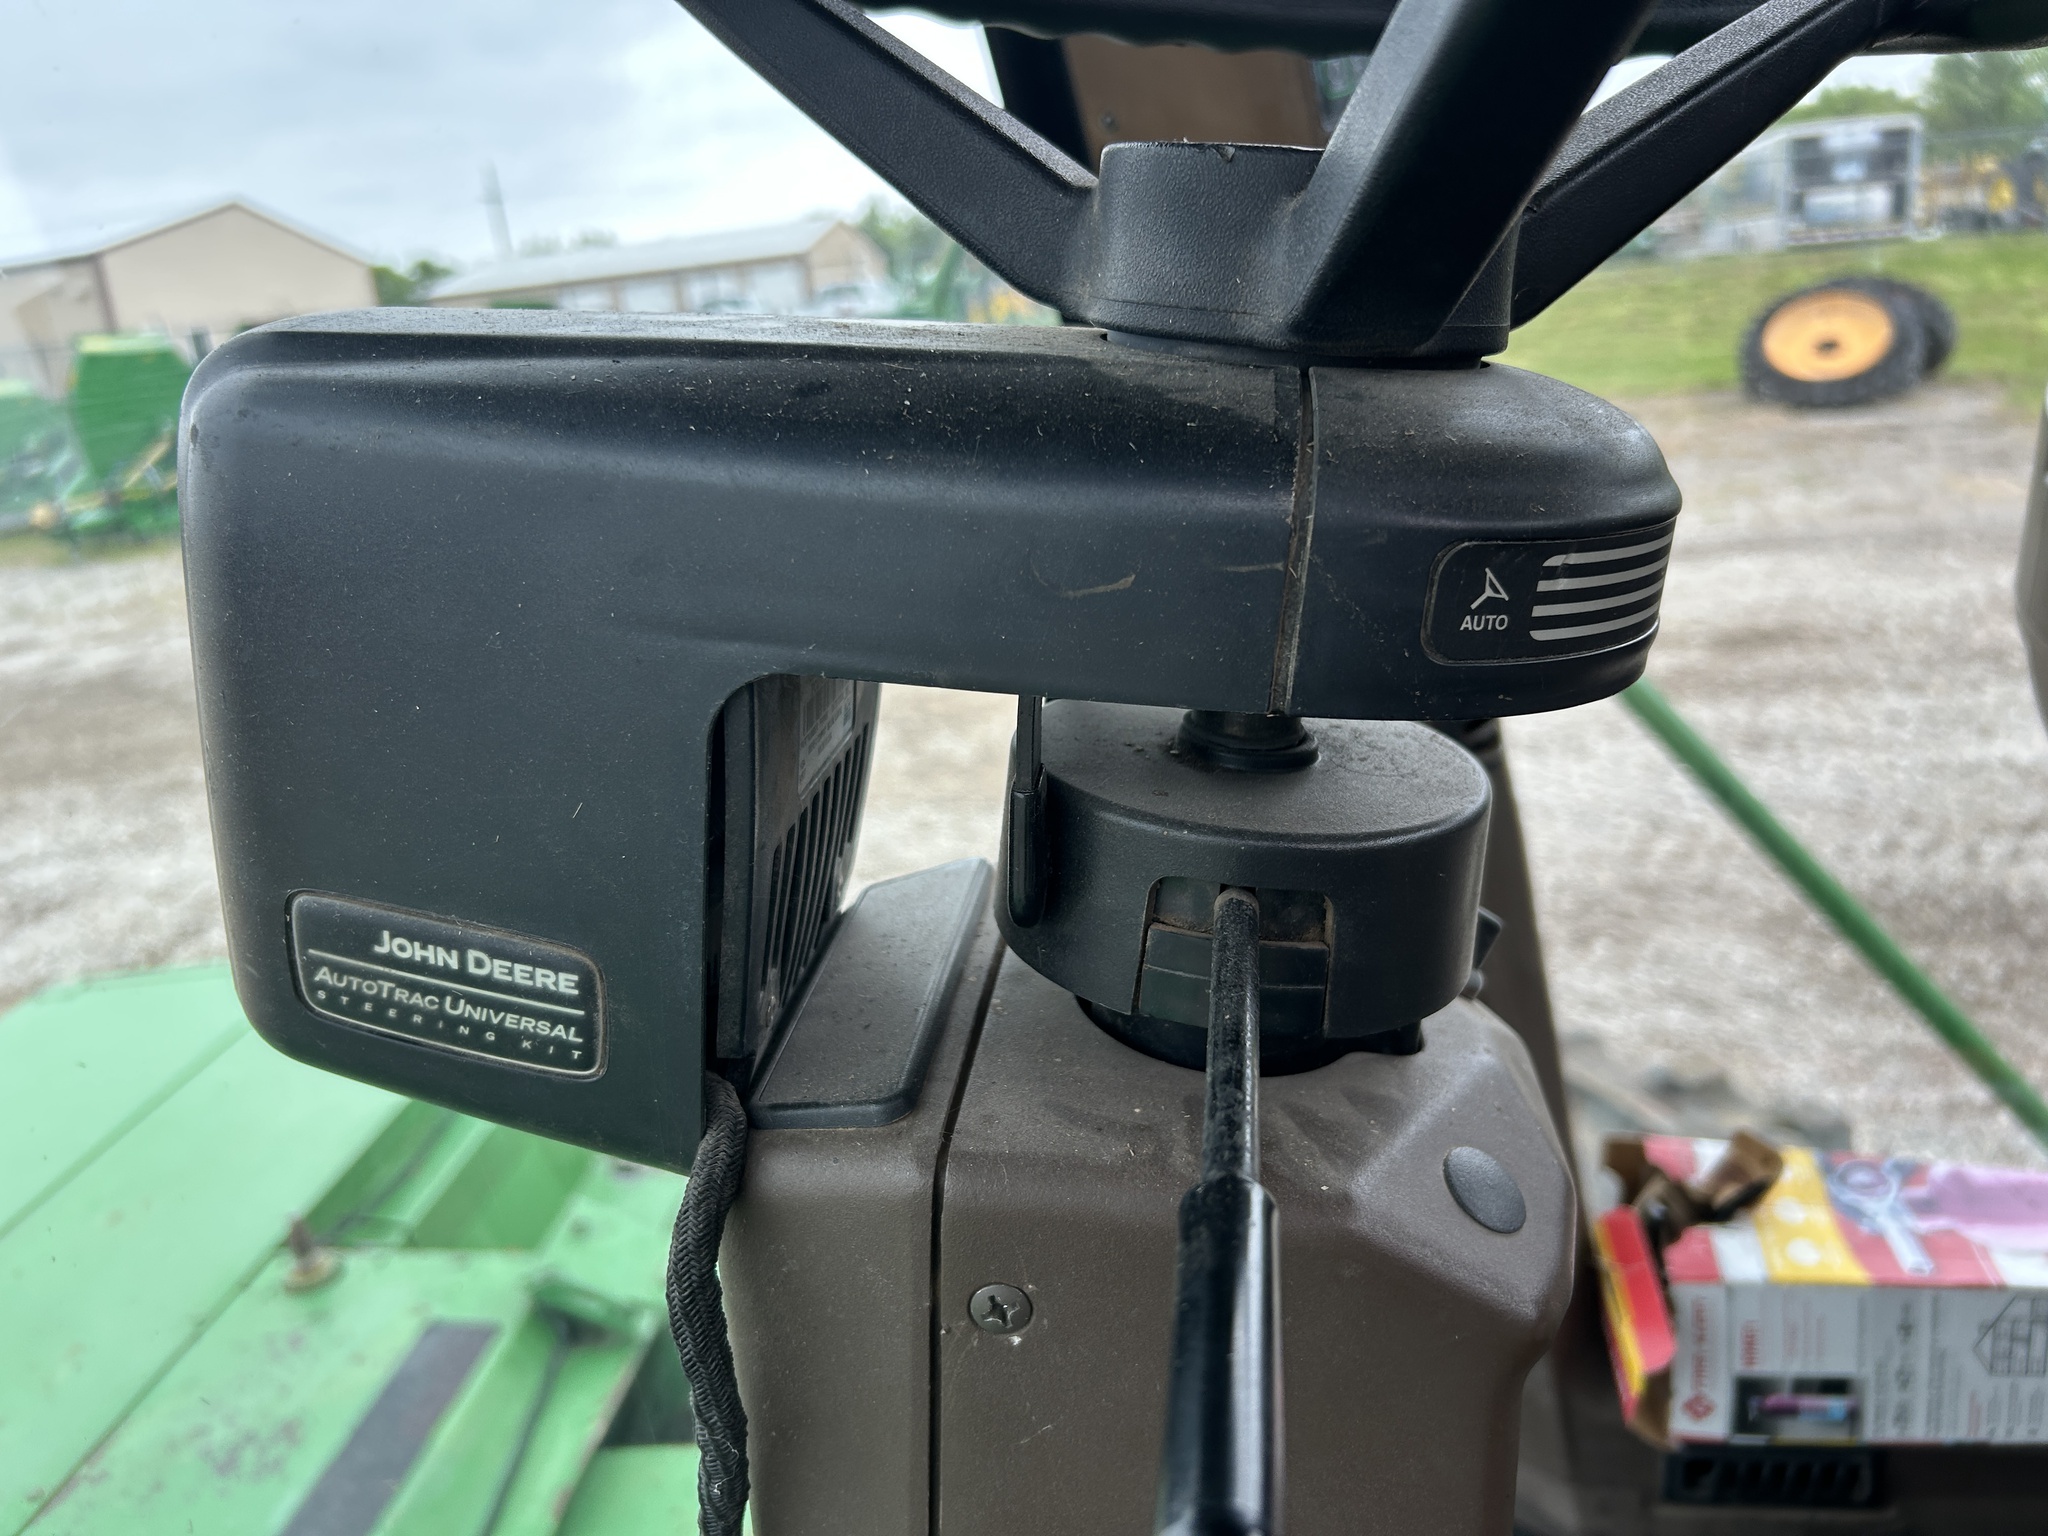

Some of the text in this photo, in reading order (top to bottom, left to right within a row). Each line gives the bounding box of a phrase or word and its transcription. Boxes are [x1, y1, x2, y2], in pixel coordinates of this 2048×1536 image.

[1459, 614, 1509, 632] AUTO
[373, 929, 580, 996] JOHN DEERE
[316, 989, 583, 1060] STEERING KIT
[444, 995, 584, 1043] UNIVERSAL
